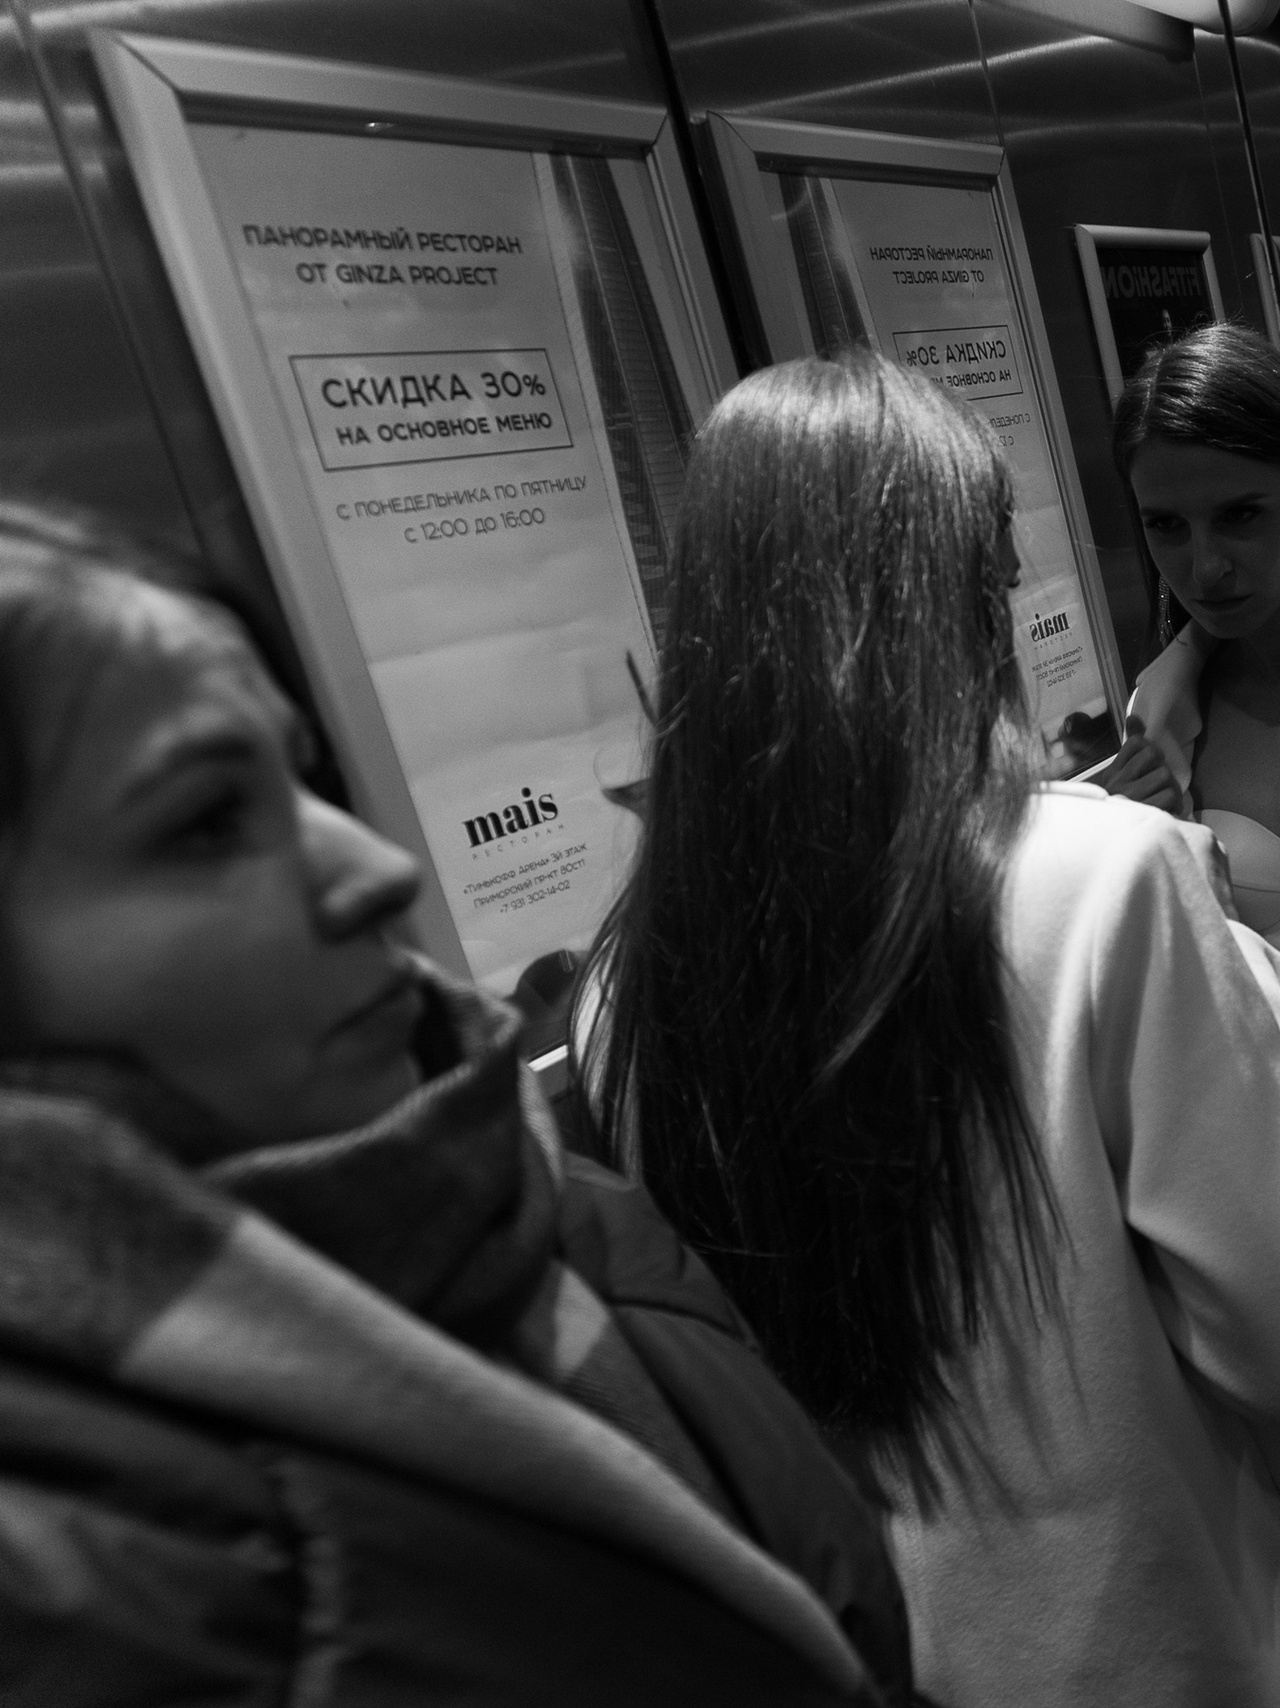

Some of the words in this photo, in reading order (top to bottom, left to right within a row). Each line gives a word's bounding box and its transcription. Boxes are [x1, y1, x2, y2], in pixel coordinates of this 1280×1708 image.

[242, 224, 413, 251] ПАНОРАМНЫЙ
[417, 232, 523, 254] РЕСТОРАН
[297, 262, 327, 284] ОТ
[336, 264, 402, 284] GINZA
[410, 267, 498, 285] PROJECT
[321, 374, 472, 409] СКИДКА
[481, 371, 546, 399] 30%
[336, 427, 371, 446] НА
[377, 416, 490, 442] ОСНОВНОЕ
[496, 412, 552, 433] МЕНЮ
[355, 488, 491, 518] ПОНЕДЕЛЬНИКА
[494, 483, 517, 500] ПО
[521, 476, 587, 497] ПЯТНИЦУ
[421, 518, 469, 540] 12:00
[500, 507, 545, 529] 16:00
[462, 787, 558, 848] mais
[472, 824, 564, 861] РЕСТОРАН
